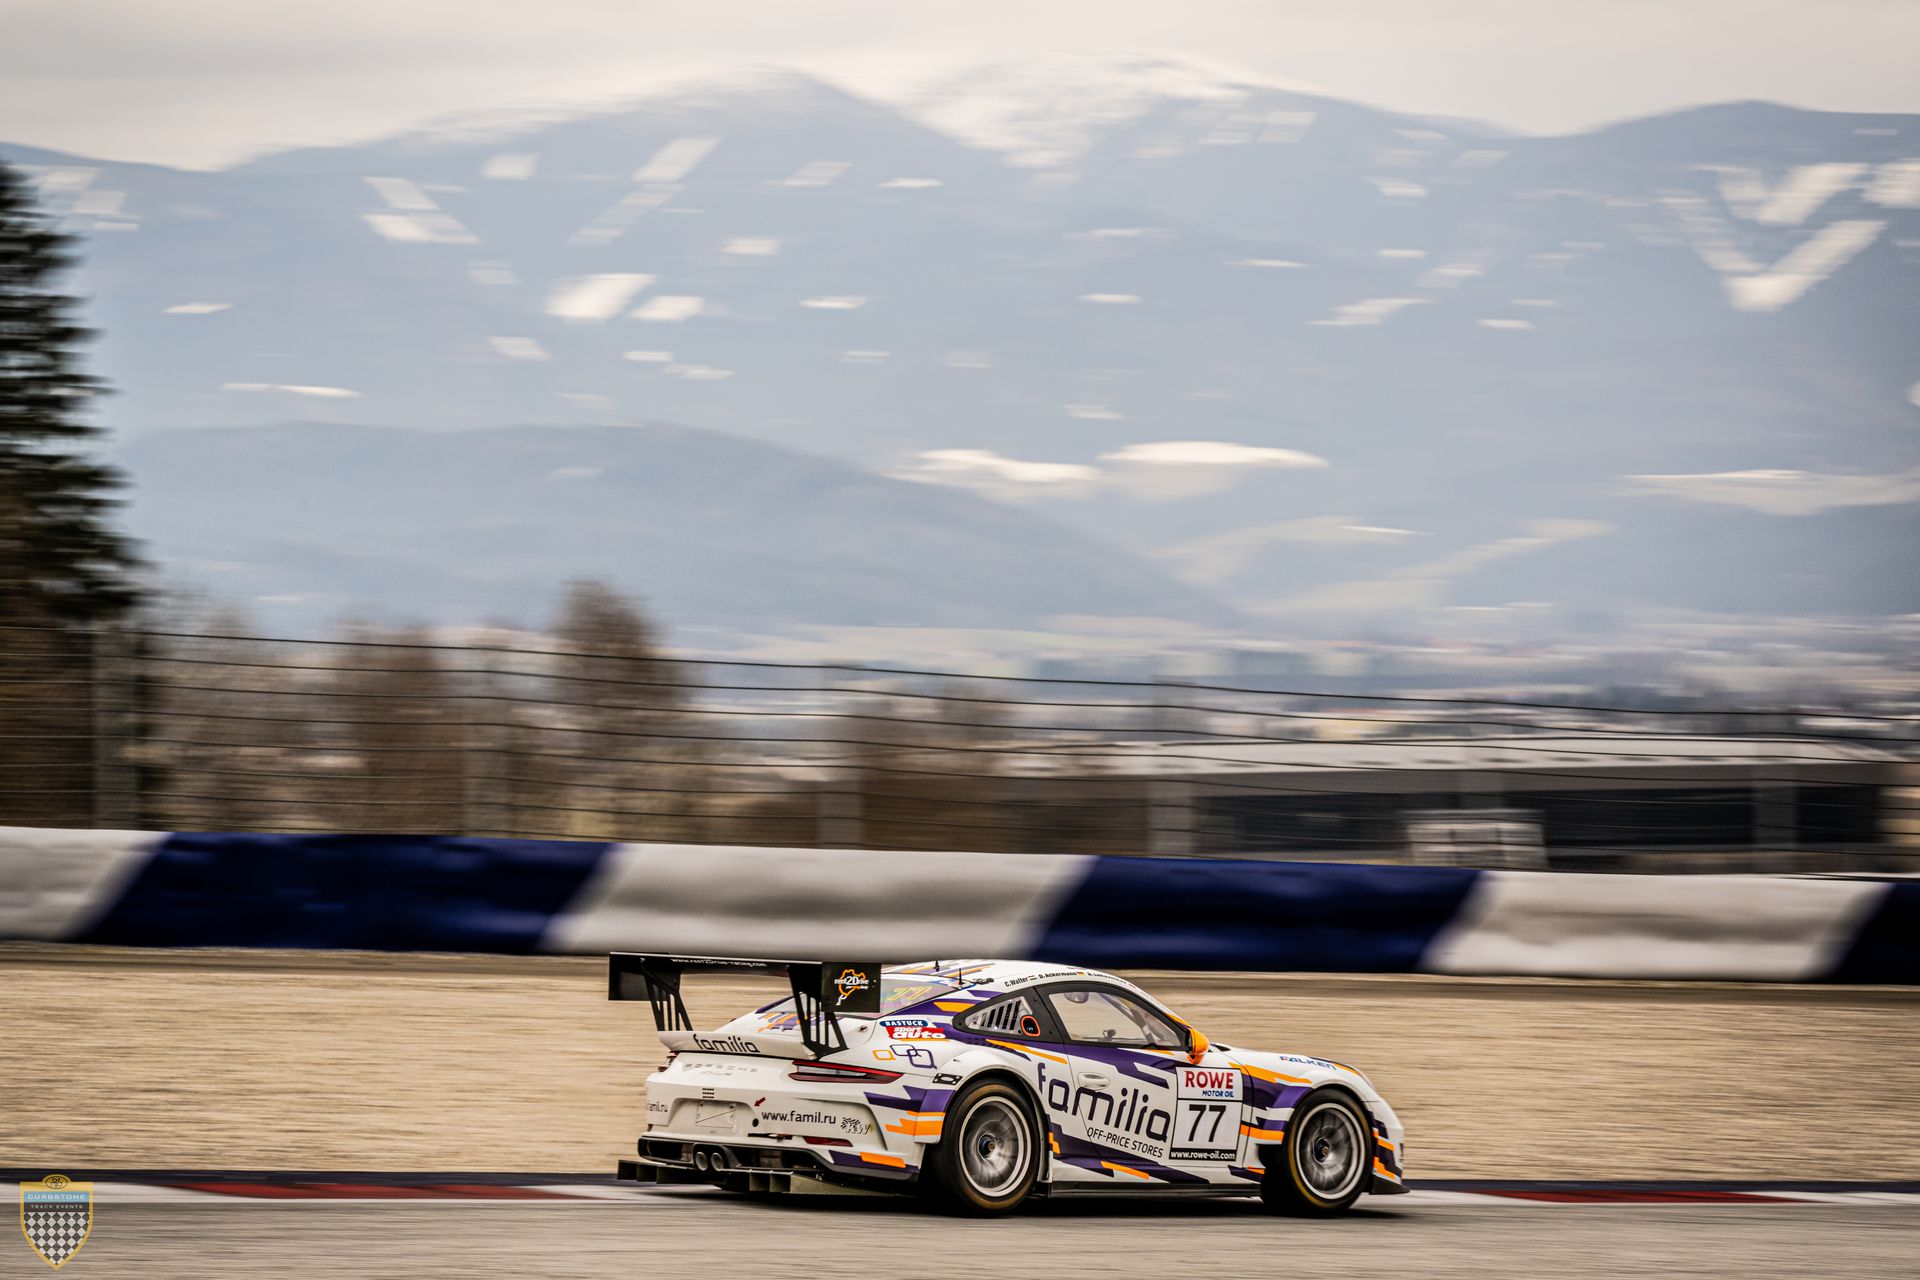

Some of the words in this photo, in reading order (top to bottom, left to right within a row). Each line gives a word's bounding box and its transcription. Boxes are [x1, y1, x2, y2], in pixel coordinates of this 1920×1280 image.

[693, 1033, 761, 1053] familia
[892, 1031, 946, 1039] auto
[1184, 1070, 1234, 1089] ROWE
[1037, 1062, 1171, 1143] familia
[761, 1110, 837, 1125] www.famil.ru
[1188, 1104, 1227, 1142] 77
[1087, 1126, 1129, 1148] OFF-PRICE
[1131, 1140, 1164, 1158] STORES
[1170, 1150, 1236, 1160] www.rowe-oil.com
